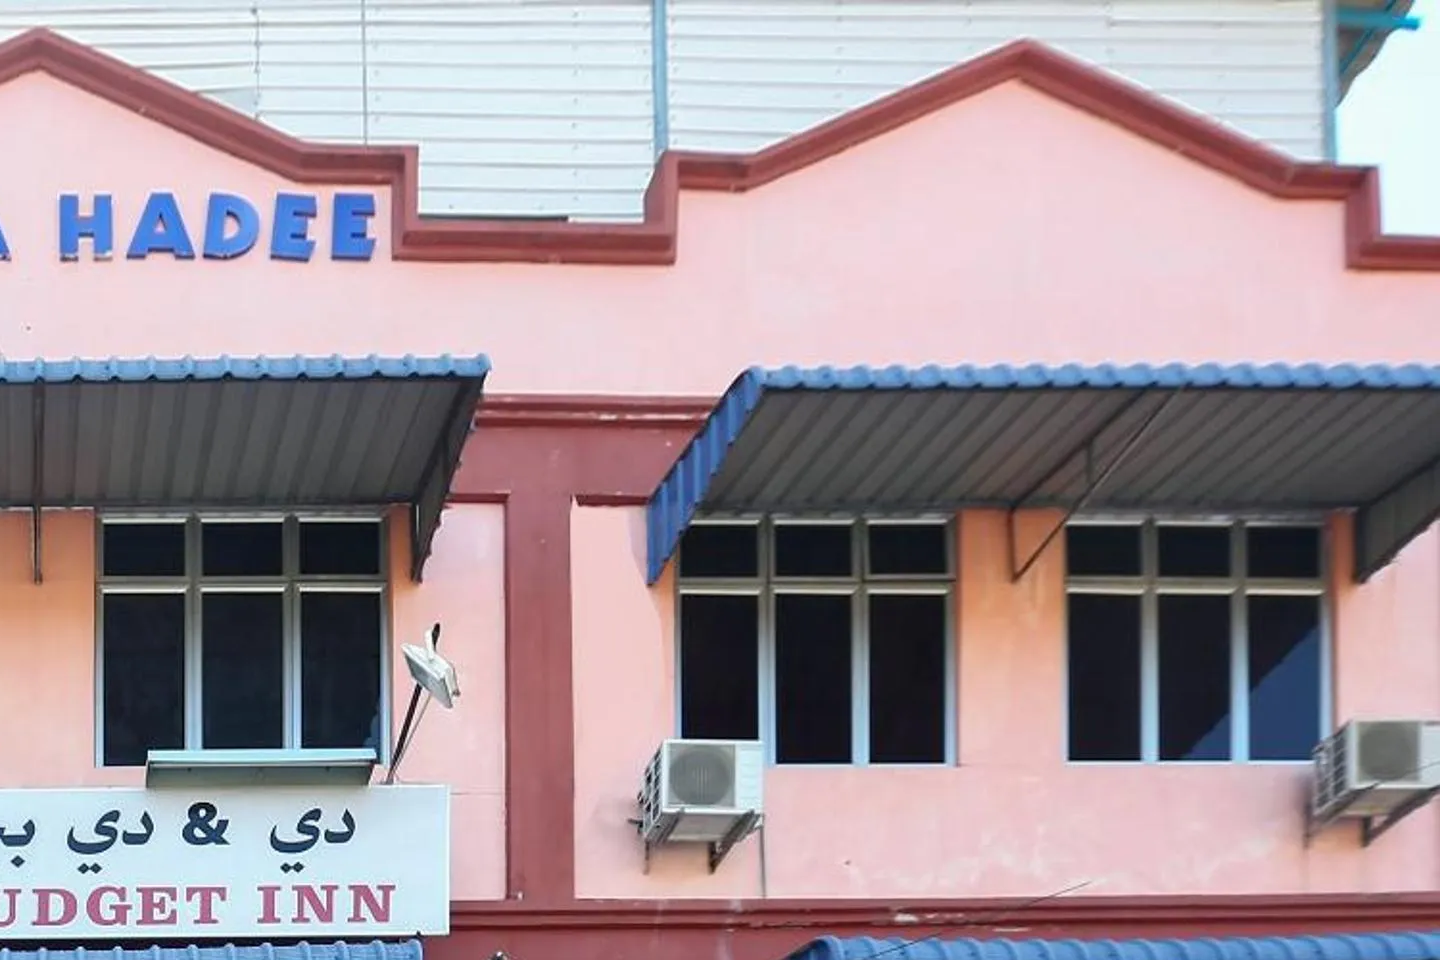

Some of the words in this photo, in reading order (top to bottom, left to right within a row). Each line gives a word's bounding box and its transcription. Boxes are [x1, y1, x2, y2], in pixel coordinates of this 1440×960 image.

[59, 191, 376, 262] HADEE
[67, 803, 153, 873] دي
[182, 801, 230, 846] &
[270, 803, 356, 873] دي
[257, 884, 396, 924] INN
